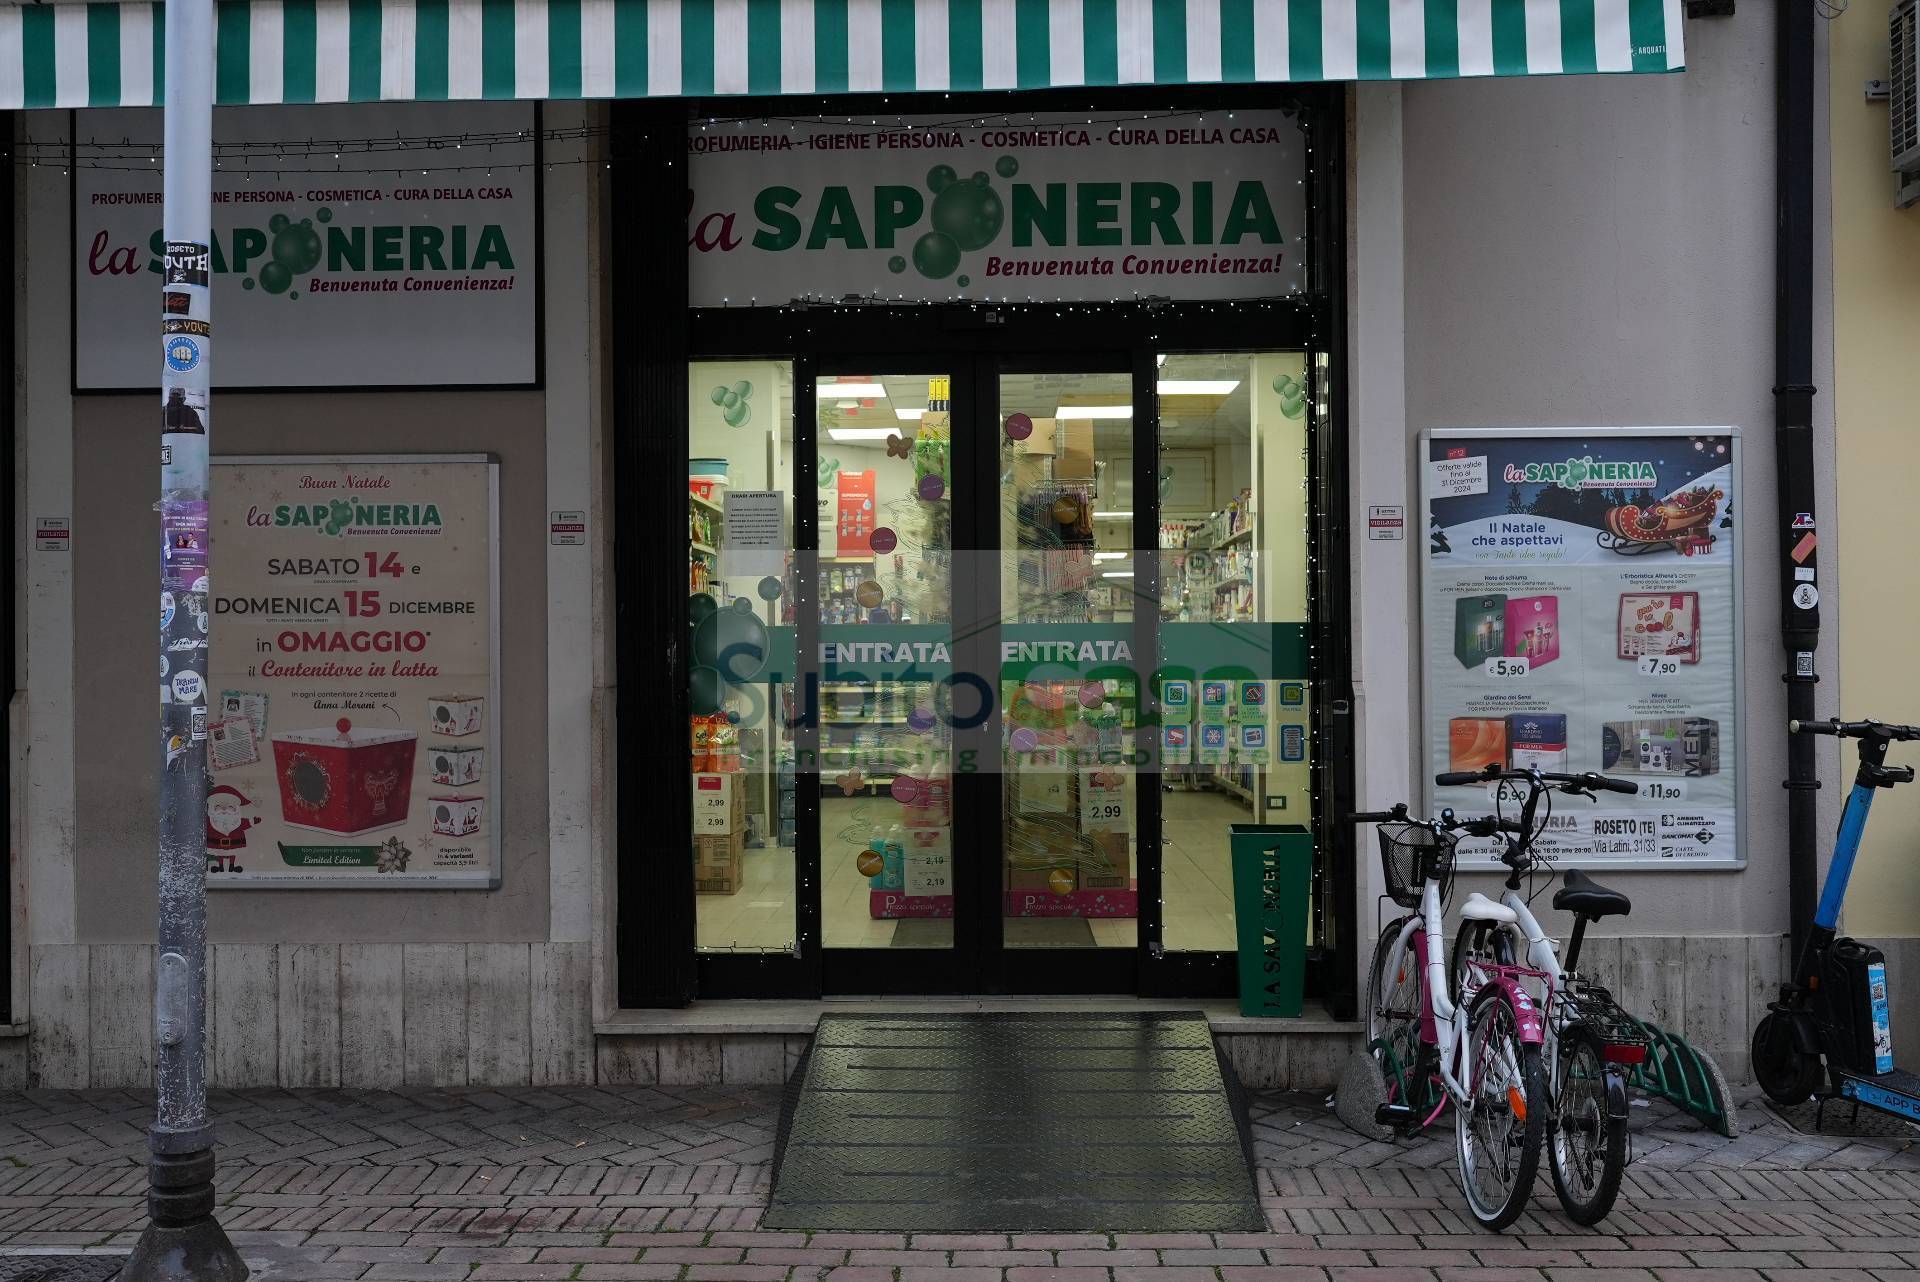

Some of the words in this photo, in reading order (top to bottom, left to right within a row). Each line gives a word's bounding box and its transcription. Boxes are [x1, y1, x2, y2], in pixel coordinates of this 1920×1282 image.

[688, 135, 792, 152] ROFUMERIA
[809, 133, 870, 150] IGIENE
[877, 131, 964, 149] PERSONA
[981, 130, 1090, 148] COSMETICA
[1108, 129, 1160, 147] CURA
[1165, 128, 1224, 146] DELLA
[1229, 127, 1280, 145] CASA
[92, 193, 164, 205] PROFUMERI
[234, 191, 296, 203] PERSONA
[306, 190, 383, 203] COSMETICA
[394, 188, 430, 202] CURA
[433, 188, 474, 201] DELLA
[476, 187, 513, 200] CASA
[688, 189, 742, 253] a
[752, 180, 1283, 251] SAPONERIA
[89, 230, 142, 275] la
[164, 253, 208, 272] OUTH
[986, 255, 1114, 278] Benvenuta
[1121, 253, 1281, 276] Convenienza!
[309, 278, 399, 293] Benvenuta
[402, 276, 514, 292] Convenienza!
[184, 321, 210, 334] YOUT
[1463, 461, 1482, 469] valide
[1504, 463, 1526, 483] la
[1524, 462, 1656, 482] SAPONERIA
[299, 475, 338, 489] Buon
[342, 474, 392, 489] Natale
[1450, 477, 1482, 485] Dicembre
[1454, 485, 1471, 493] 2024
[246, 505, 272, 528] la
[274, 504, 442, 526] SAPONERIA
[347, 527, 389, 536] Benvenuta
[390, 526, 442, 536] Convenienza!
[1489, 522, 1496, 534] Il
[1502, 522, 1546, 534] Natale
[1472, 535, 1496, 546] che
[1500, 534, 1564, 548] aspettavi
[268, 558, 360, 576] SABATO
[364, 551, 406, 578] 14
[411, 564, 421, 575] e
[215, 597, 341, 615] DOMENICA
[344, 590, 381, 618] 15
[390, 601, 475, 614] DICEMBRE
[257, 637, 272, 652] in
[1001, 640, 1134, 663] ENTRATA
[819, 643, 951, 664] ENTRATA
[248, 666, 255, 677] il
[261, 660, 363, 677] Contenitore
[368, 663, 386, 677] in
[392, 660, 439, 677] latta
[1497, 660, 1524, 678] 5,90
[1649, 659, 1676, 677] 7,90
[300, 691, 316, 699] ogni
[317, 690, 358, 698] contenitore
[365, 690, 388, 698] ricette
[390, 690, 397, 698] di
[314, 699, 338, 710] Anna
[1499, 786, 1526, 802] 6,90
[1641, 789, 1647, 797] €
[1649, 784, 1681, 800] 11,90
[708, 799, 725, 808] 2,99
[1091, 806, 1121, 821] 2,99
[708, 818, 725, 827] 2,99
[1594, 819, 1636, 835] ROSETO
[1639, 821, 1656, 837] (TE)
[1594, 840, 1607, 852] Via
[1609, 839, 1632, 854] Latini,
[1634, 839, 1656, 853] 31/33
[303, 855, 333, 865] Limited
[334, 855, 361, 865] Edition
[926, 856, 944, 866] 2,19
[927, 878, 945, 888] 2,19
[1884, 1095, 1910, 1110] APP
